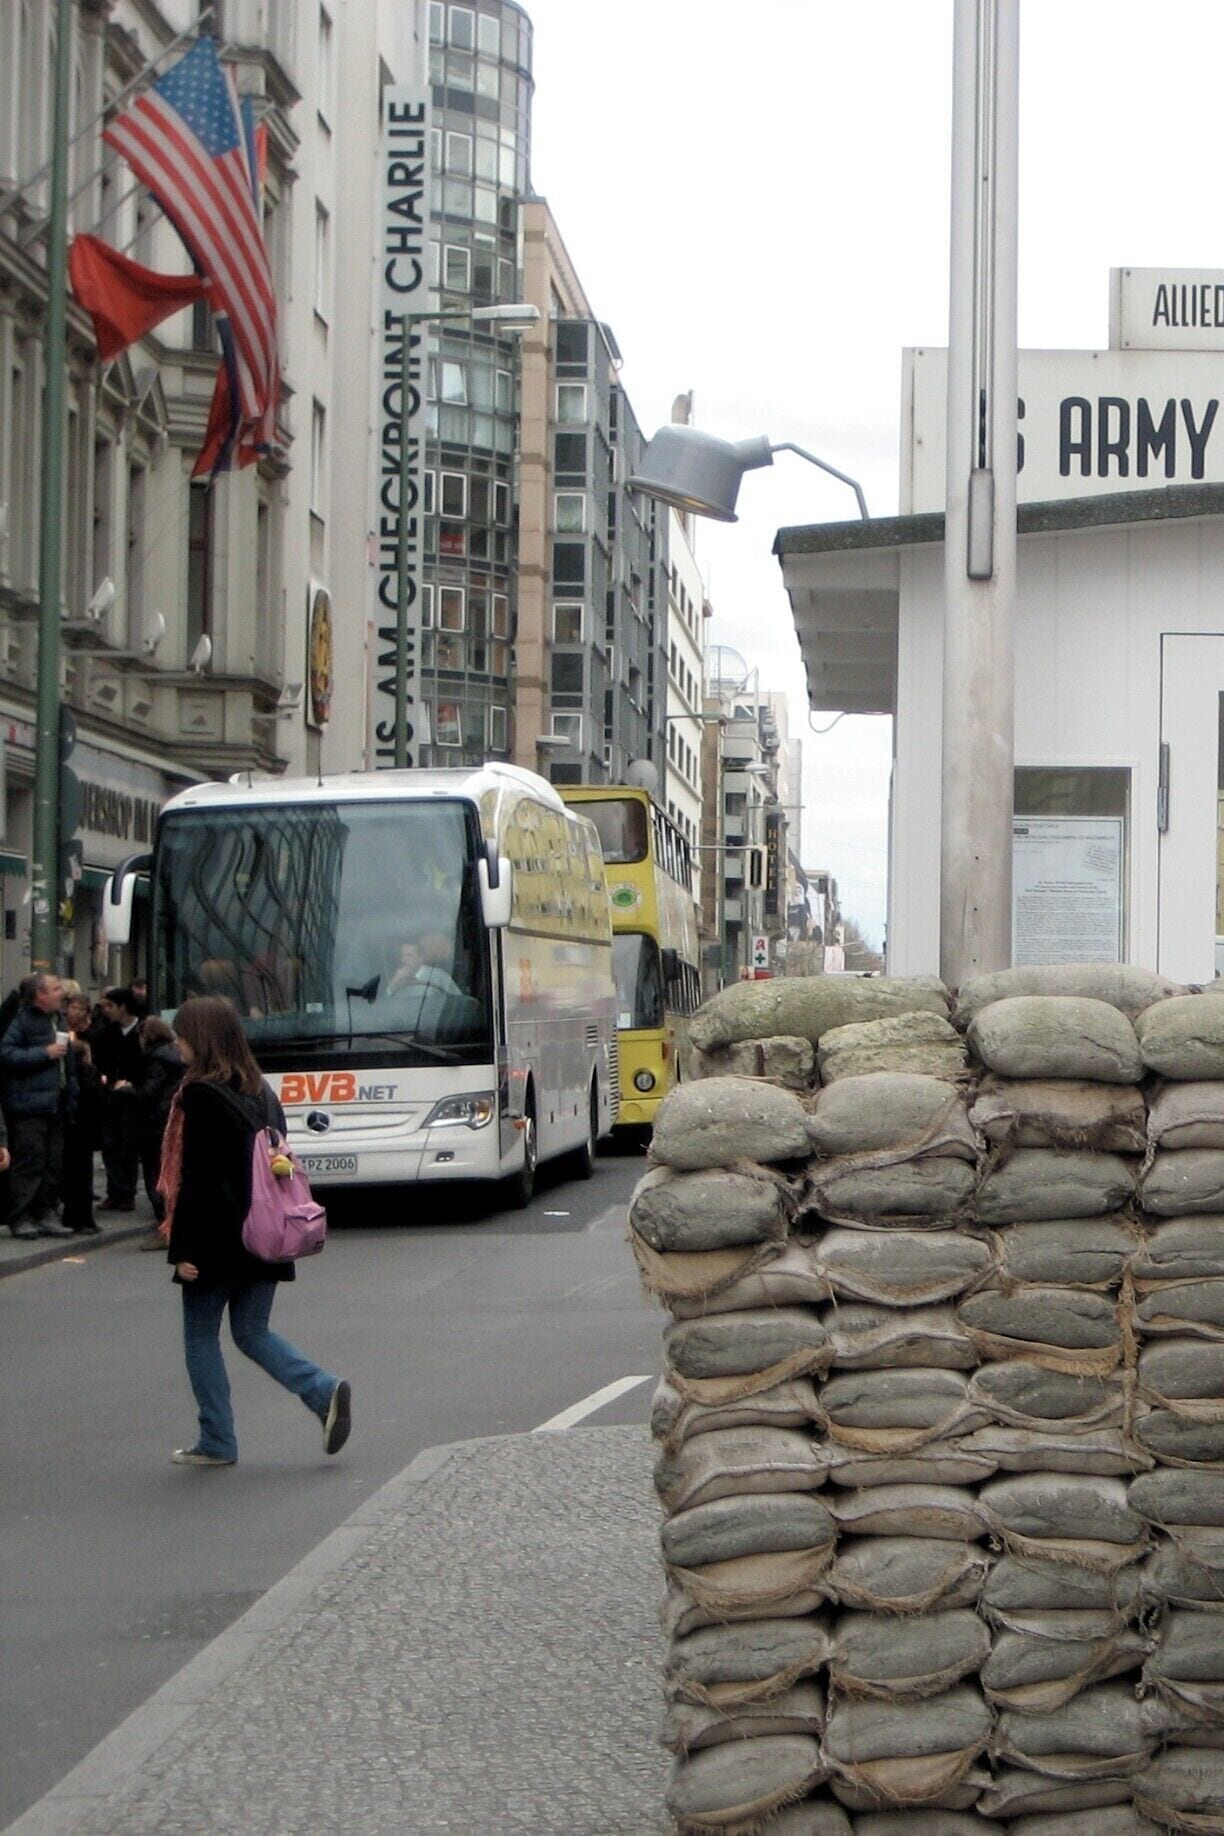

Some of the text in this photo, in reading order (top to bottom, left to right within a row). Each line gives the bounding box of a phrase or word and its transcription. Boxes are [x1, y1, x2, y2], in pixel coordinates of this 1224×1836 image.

[384, 102, 425, 294] CHARLIE
[378, 309, 422, 611] CHECKPOINT
[1059, 396, 1219, 480] ARMY
[767, 828, 778, 890] HOTEL
[325, 1158, 355, 1170] 2006
